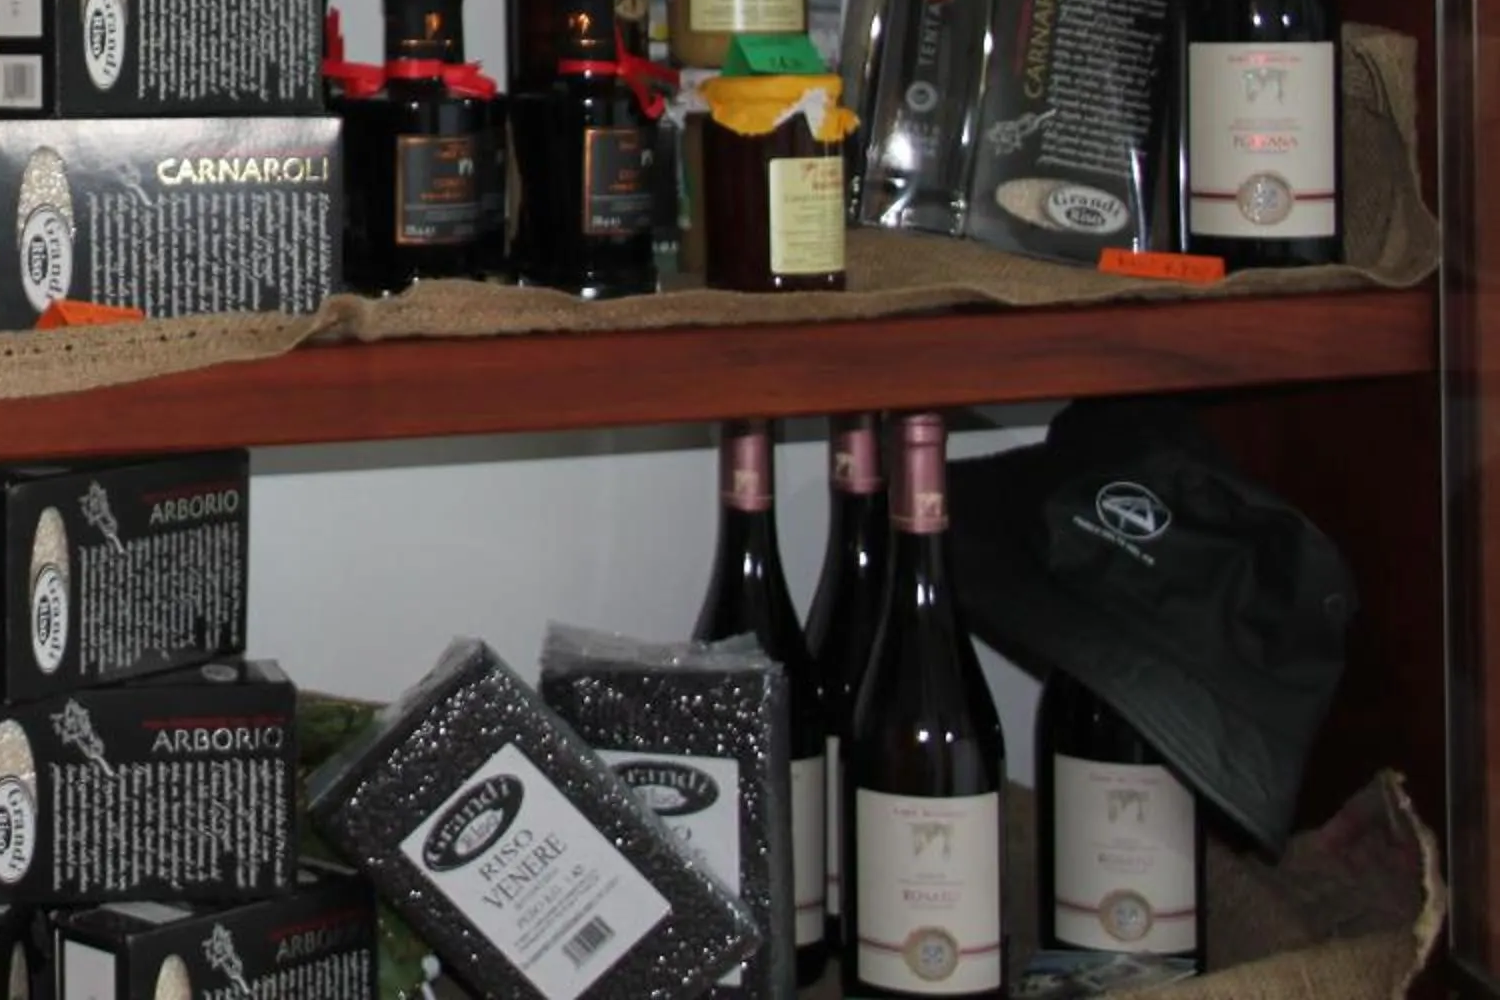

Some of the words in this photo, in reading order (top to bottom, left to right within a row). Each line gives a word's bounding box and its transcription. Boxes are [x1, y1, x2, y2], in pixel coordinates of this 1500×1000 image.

[156, 157, 329, 186] CARNAROLI
[1052, 190, 1121, 219] Grandi
[31, 240, 46, 282] Riso
[150, 490, 240, 524] ARBORIO
[152, 726, 284, 752] ARBORIO
[616, 768, 708, 794] randi
[7, 786, 27, 871] Grandi
[428, 781, 510, 863] Grandi
[479, 829, 534, 882] RISO
[483, 834, 568, 910] VENERE
